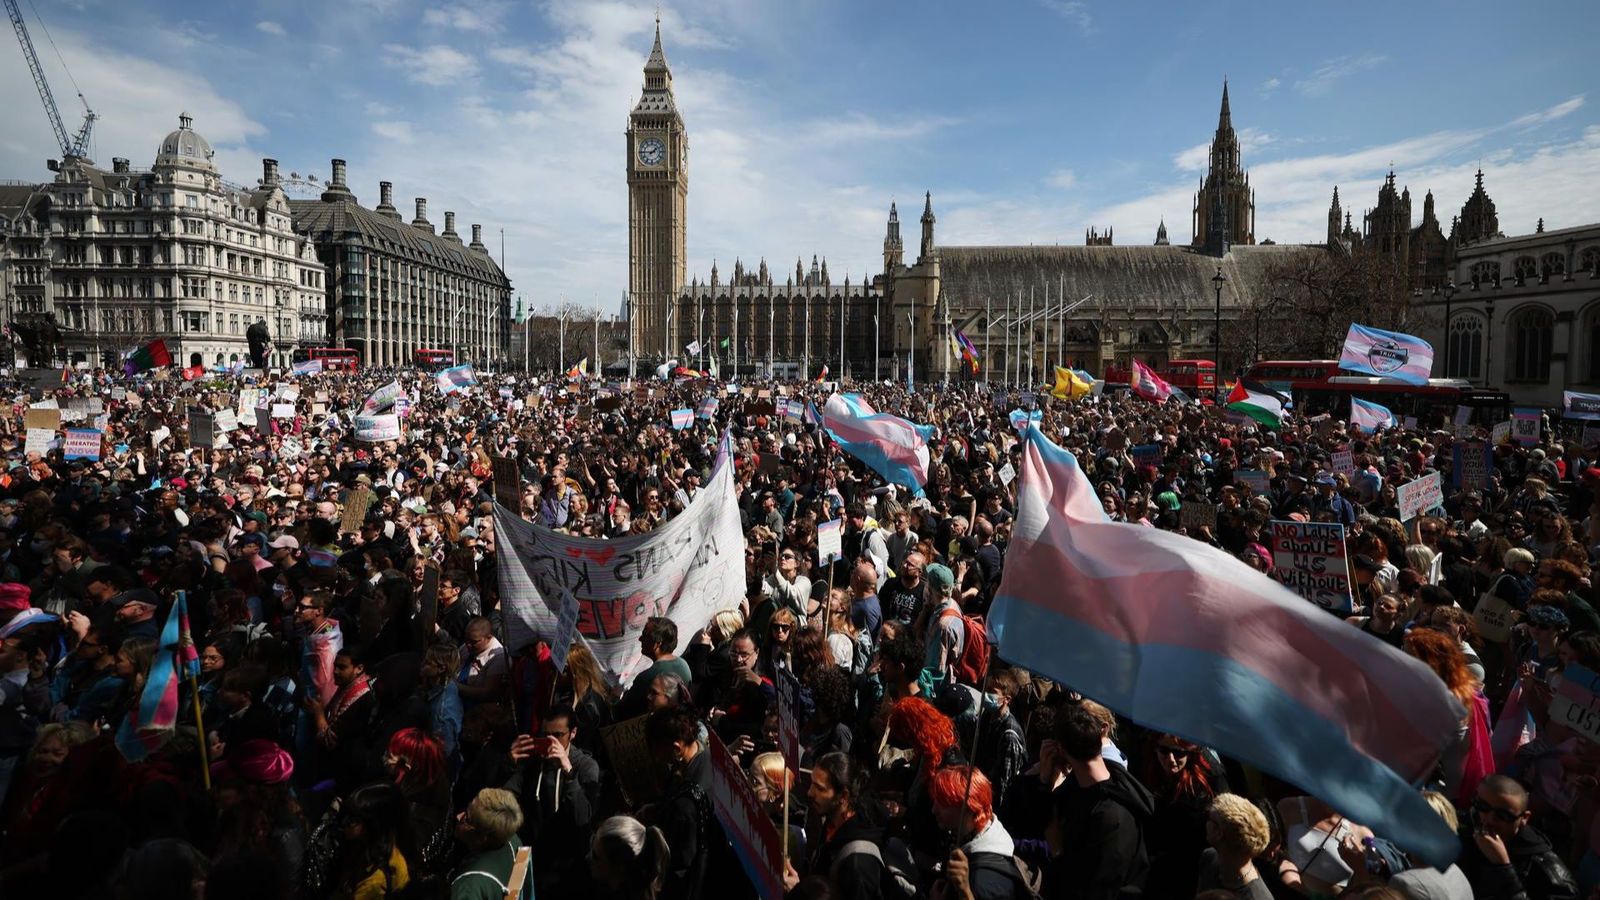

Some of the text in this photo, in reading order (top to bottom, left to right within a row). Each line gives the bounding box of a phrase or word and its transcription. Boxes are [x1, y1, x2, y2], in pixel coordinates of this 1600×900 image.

[1275, 523, 1297, 537] NO
[1281, 538, 1336, 555] about
[1294, 552, 1327, 573] US
